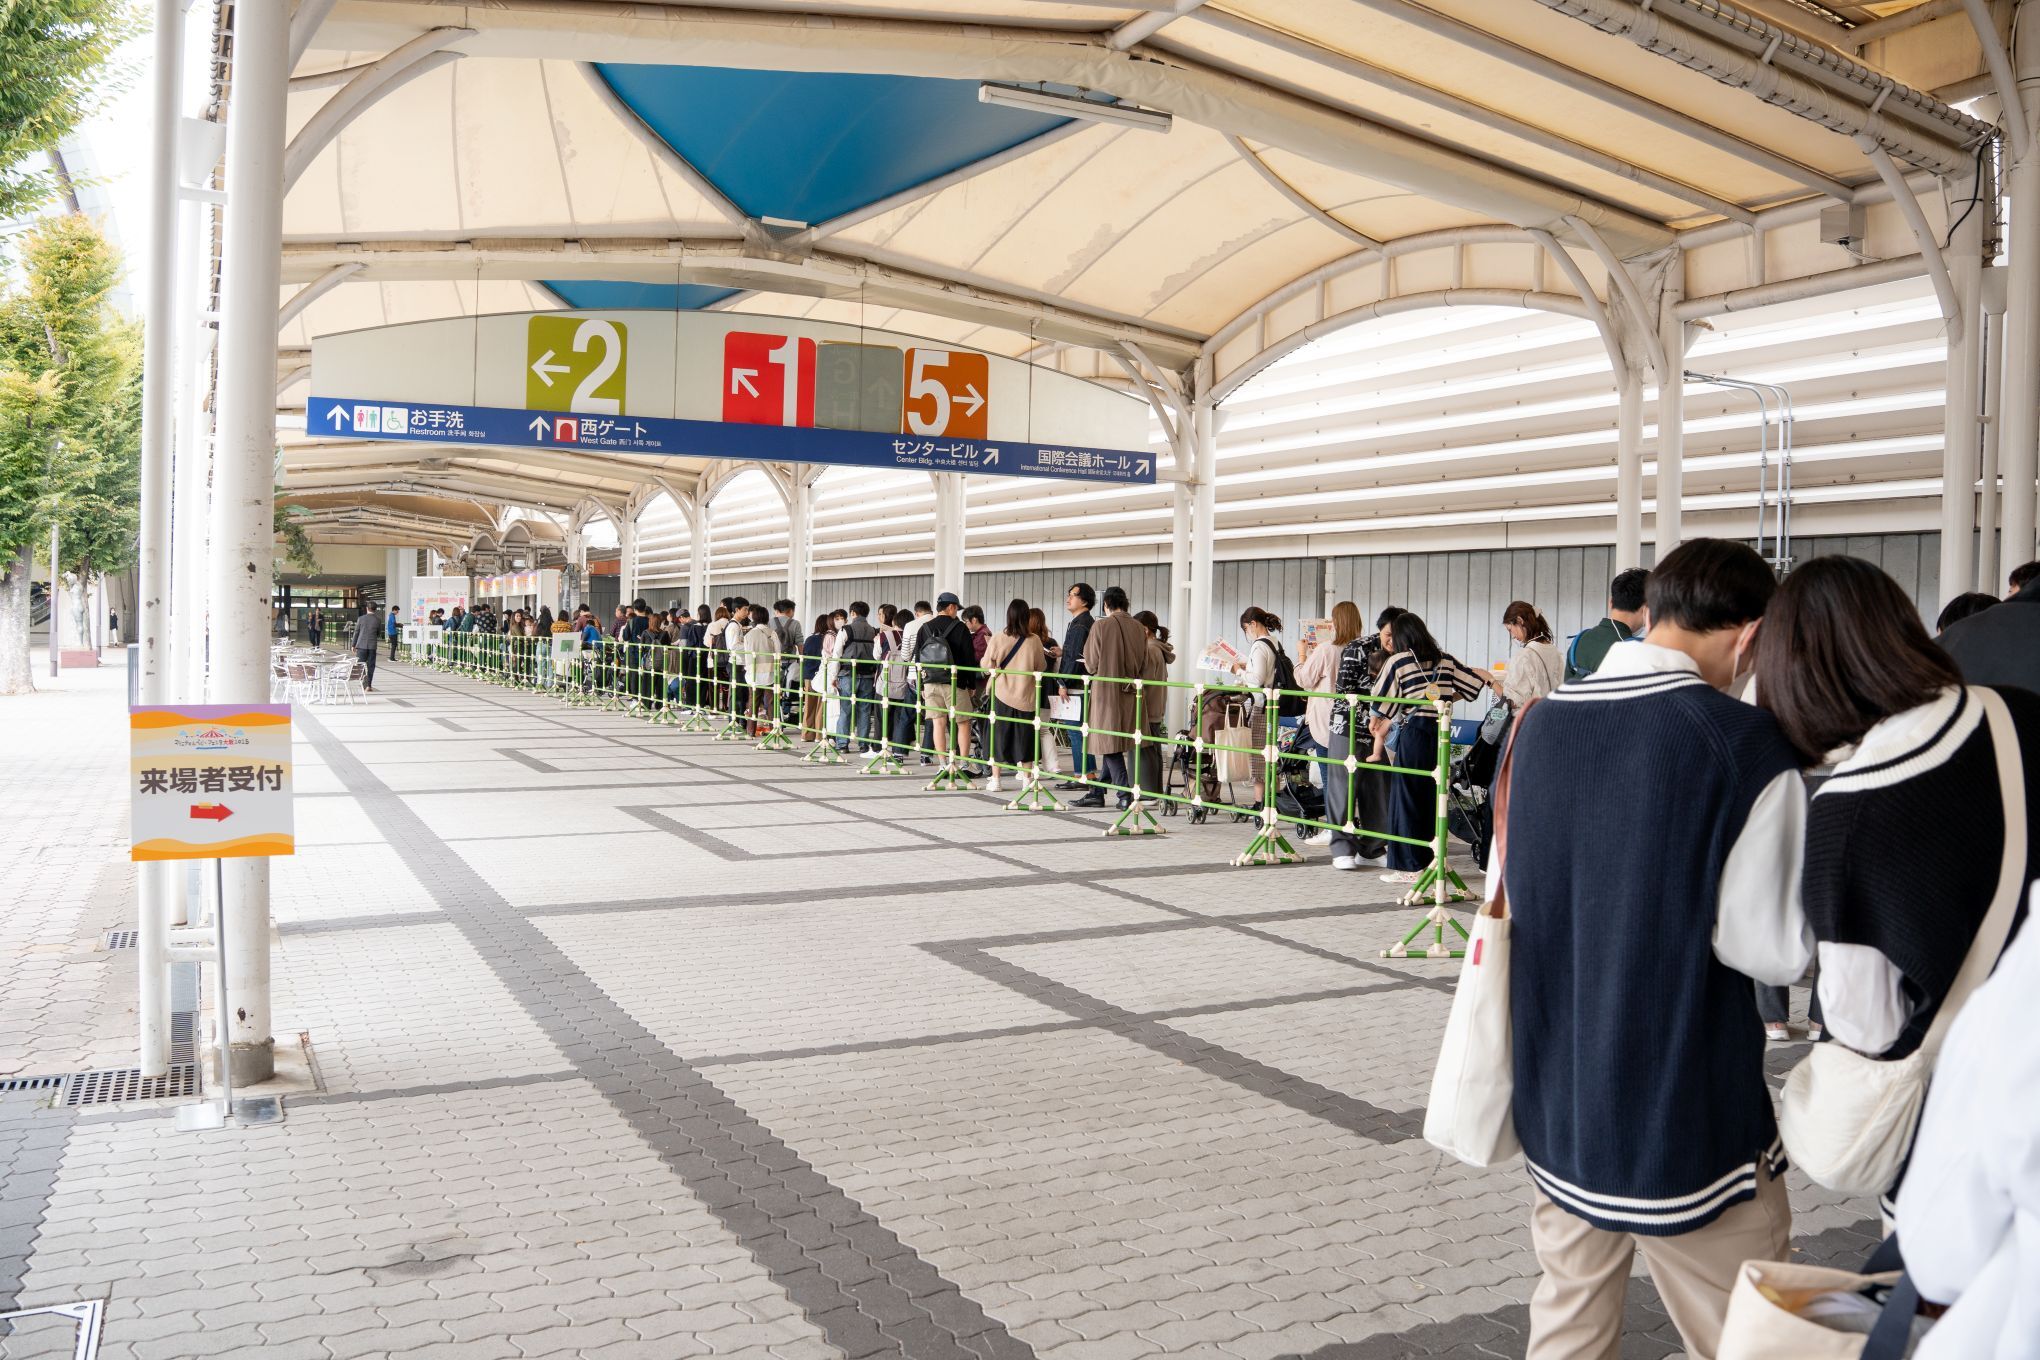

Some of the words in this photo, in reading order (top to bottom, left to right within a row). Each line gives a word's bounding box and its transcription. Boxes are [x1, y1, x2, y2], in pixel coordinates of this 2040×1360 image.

[570, 319, 621, 416] 2
[768, 335, 798, 427] 1
[907, 348, 950, 437] 5
[410, 409, 464, 429] お手洗
[580, 418, 647, 439] 西ゲート
[409, 427, 446, 437] Restroom
[580, 436, 599, 445] West
[600, 437, 617, 446] Gate
[892, 439, 979, 459] センタービル
[896, 455, 917, 464] Center
[918, 456, 934, 466] Bldg.
[1020, 463, 1050, 472] International
[1050, 466, 1077, 475] Conference
[1038, 449, 1131, 470] 国際会議ホール
[140, 764, 284, 795] 来場者受付
